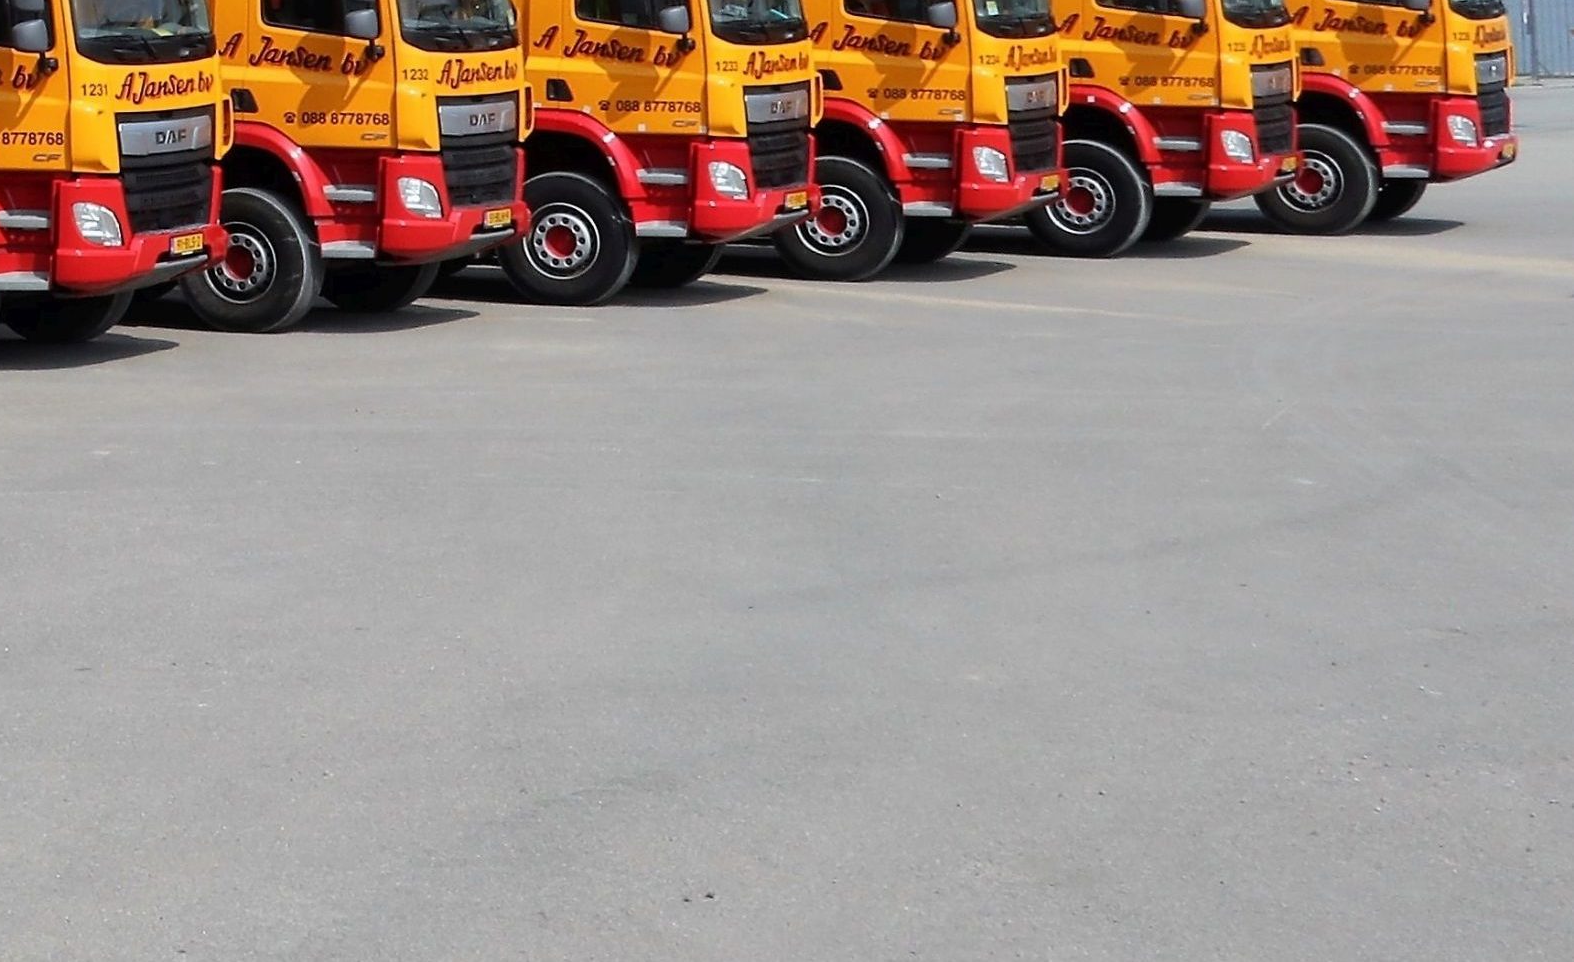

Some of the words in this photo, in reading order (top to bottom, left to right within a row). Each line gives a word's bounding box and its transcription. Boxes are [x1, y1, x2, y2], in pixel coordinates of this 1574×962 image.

[1314, 8, 1388, 34] Jansen
[1083, 16, 1160, 45] Jansen
[533, 25, 559, 50] A
[563, 29, 645, 63] Jansen
[808, 21, 828, 43] A
[832, 24, 912, 57] Jansen
[218, 32, 244, 59] A
[249, 36, 332, 71] Jansen
[402, 69, 428, 80] 1232
[82, 83, 108, 96] 1231
[616, 100, 640, 112] 088
[644, 100, 701, 113] 8778768
[302, 112, 327, 124] 088
[331, 112, 389, 125] 8778768
[469, 113, 495, 126] DAF
[2, 131, 64, 146] 8778768
[155, 129, 187, 145] DAF
